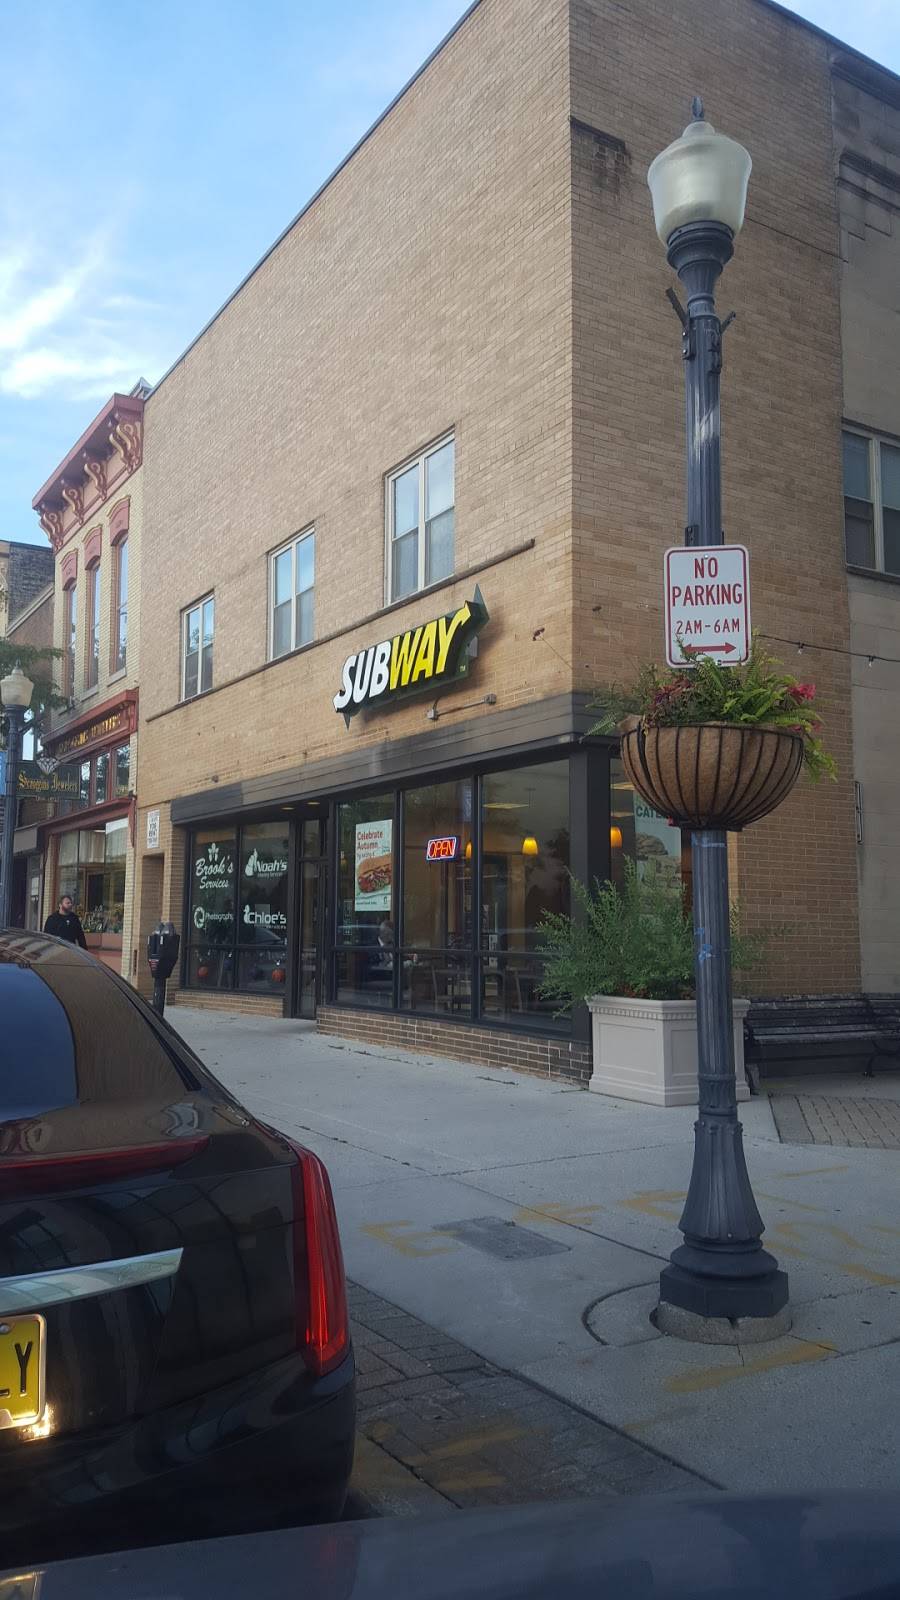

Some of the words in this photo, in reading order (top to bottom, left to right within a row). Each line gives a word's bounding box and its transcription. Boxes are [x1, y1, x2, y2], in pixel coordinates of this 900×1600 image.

[694, 557, 718, 579] NO
[672, 583, 742, 607] PARKING
[333, 602, 471, 711] SUBWAY
[357, 830, 383, 840] Celebrate
[430, 841, 454, 857] OPEN
[195, 855, 234, 877] Brook's
[255, 860, 287, 872] Noah's
[199, 876, 229, 889] Services
[248, 911, 287, 924] Chloe's
